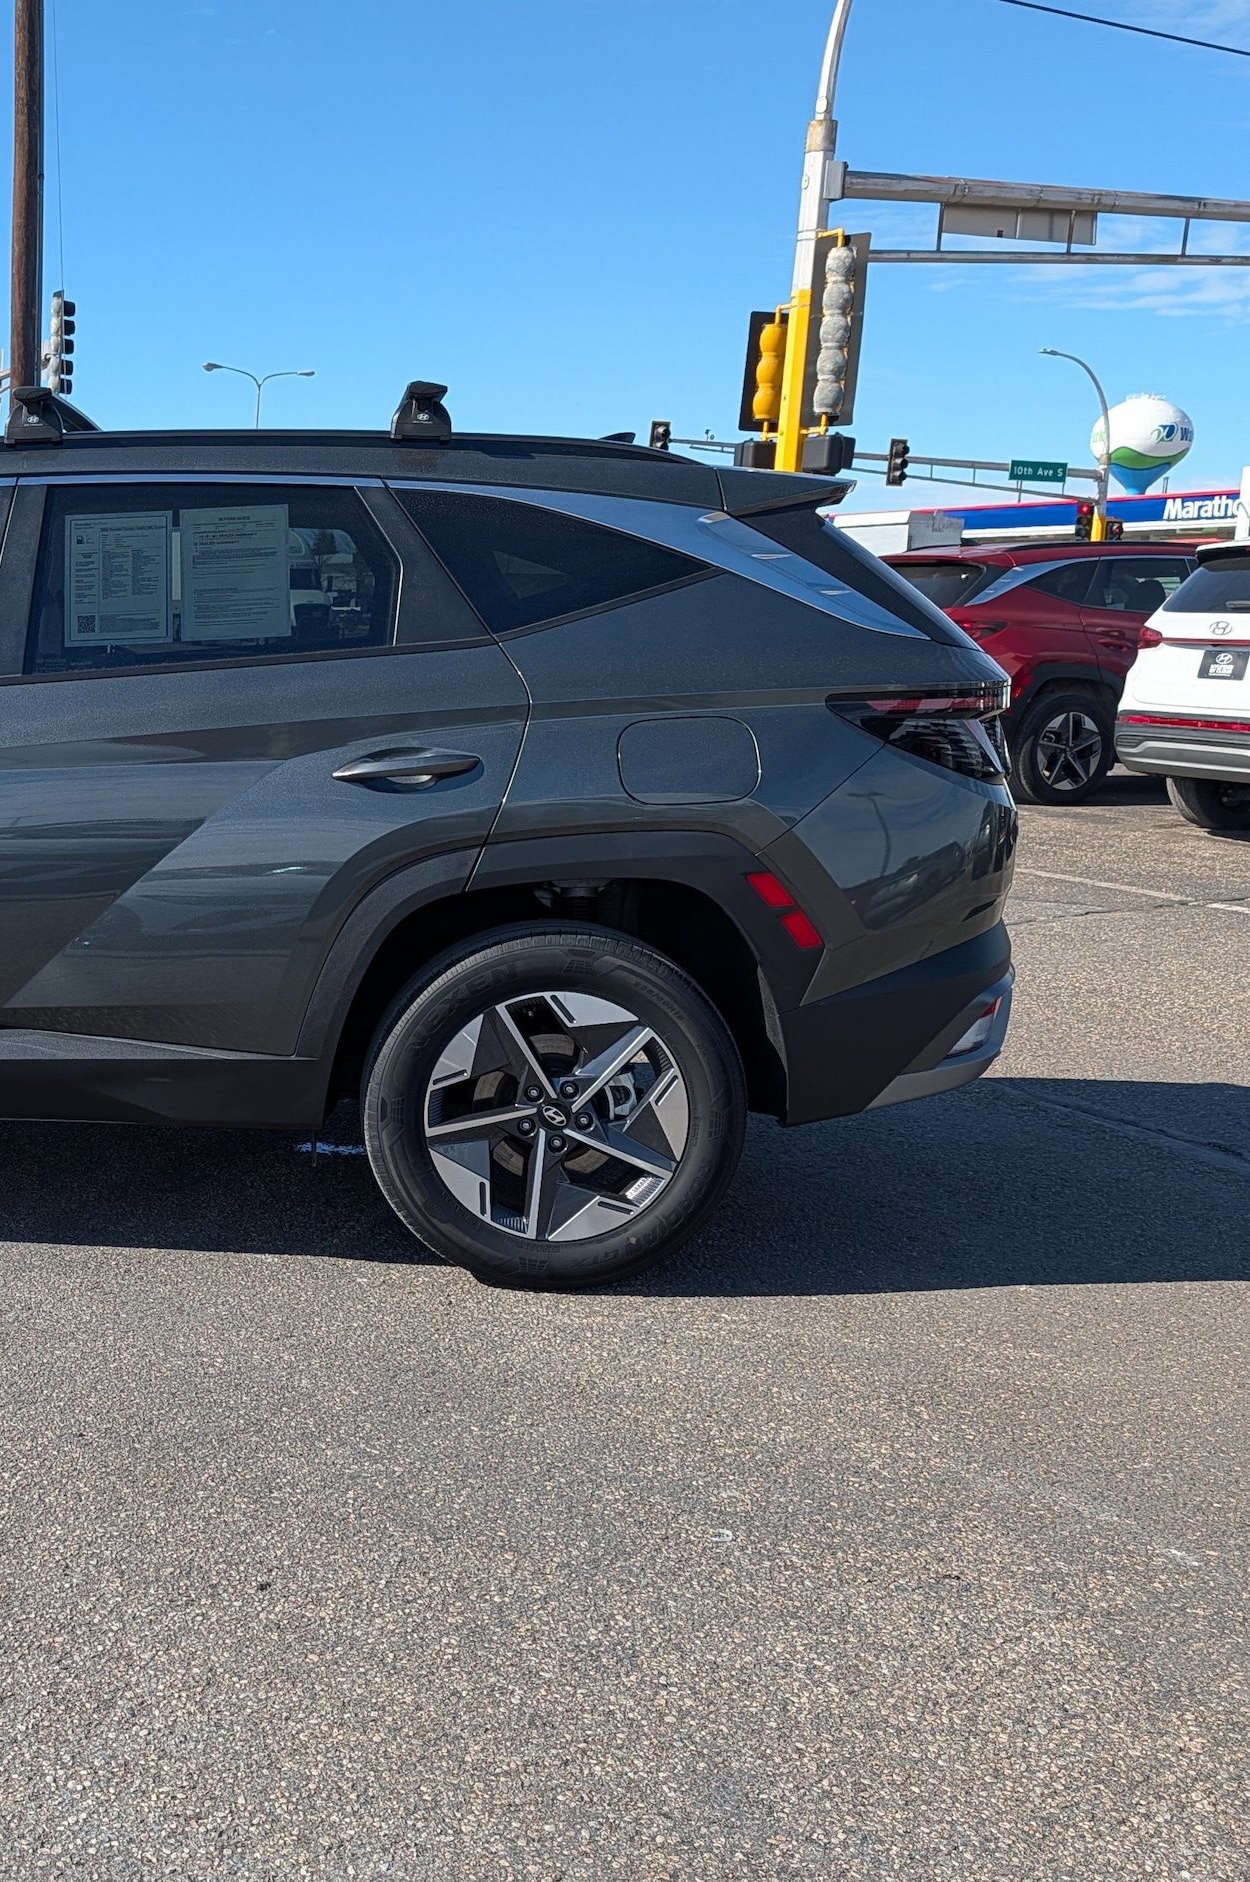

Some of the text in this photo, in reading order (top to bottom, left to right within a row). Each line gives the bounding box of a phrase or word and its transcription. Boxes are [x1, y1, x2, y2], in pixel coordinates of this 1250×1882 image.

[1013, 465, 1064, 478] 10th Ave S
[1162, 495, 1241, 520] Maratho
[404, 963, 520, 1058] NEXEN
